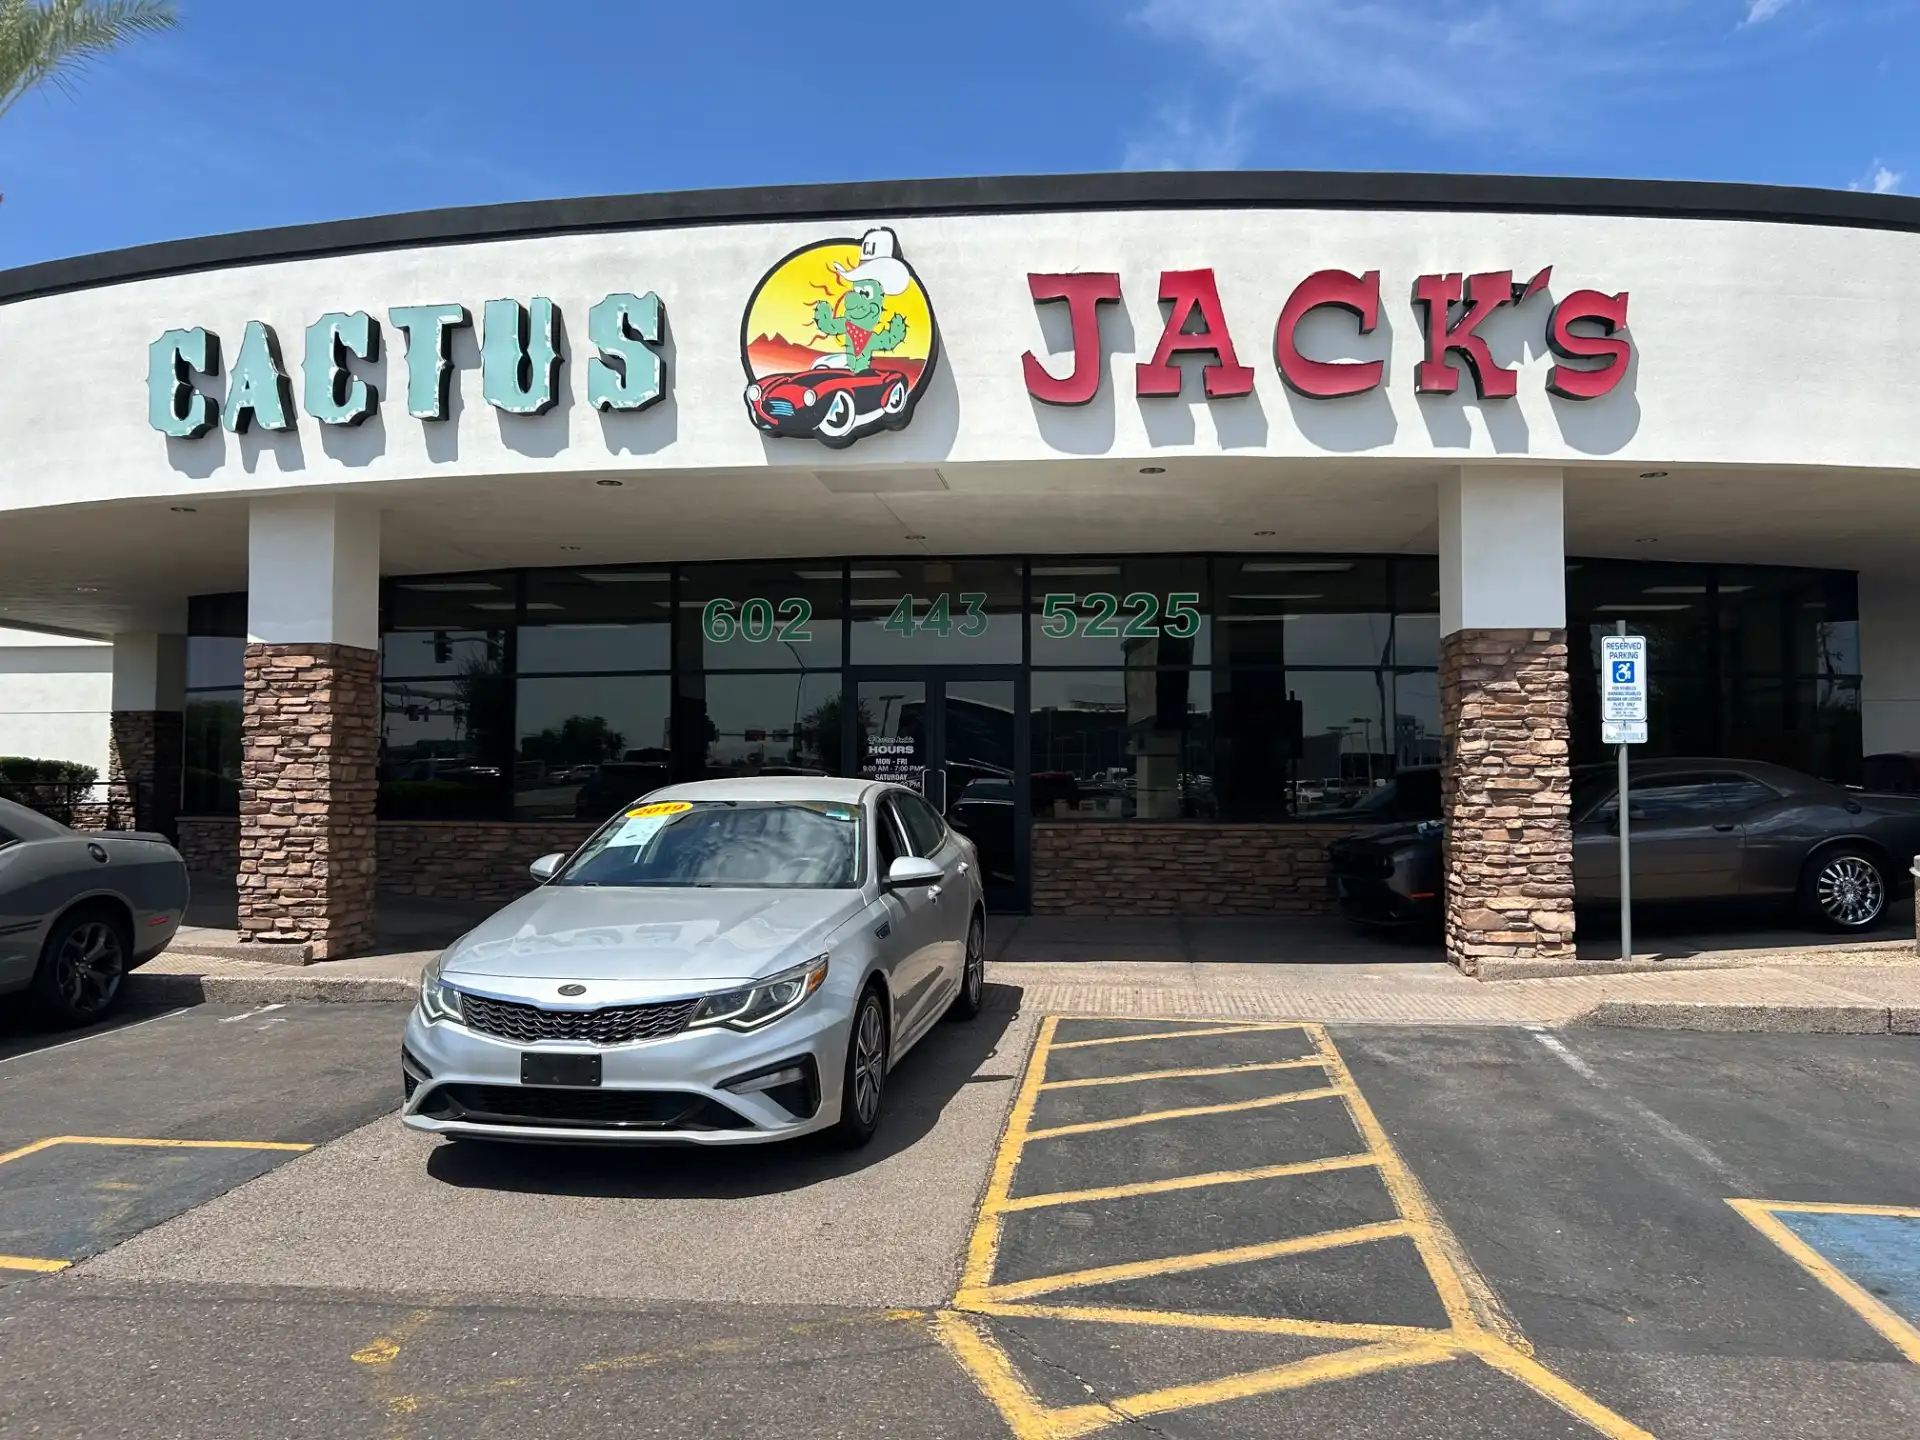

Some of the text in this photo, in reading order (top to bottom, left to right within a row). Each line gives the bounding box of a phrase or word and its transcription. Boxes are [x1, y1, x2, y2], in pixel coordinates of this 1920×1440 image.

[863, 241, 876, 256] CJ
[146, 292, 666, 440] CACTUS
[702, 592, 1202, 643] 602 443 5225
[1606, 642, 1642, 650] RESERVED
[1609, 651, 1639, 659] PARKING
[868, 745, 914, 754] HOURS
[874, 773, 908, 781] SATURDAY
[631, 804, 685, 817] 2019
